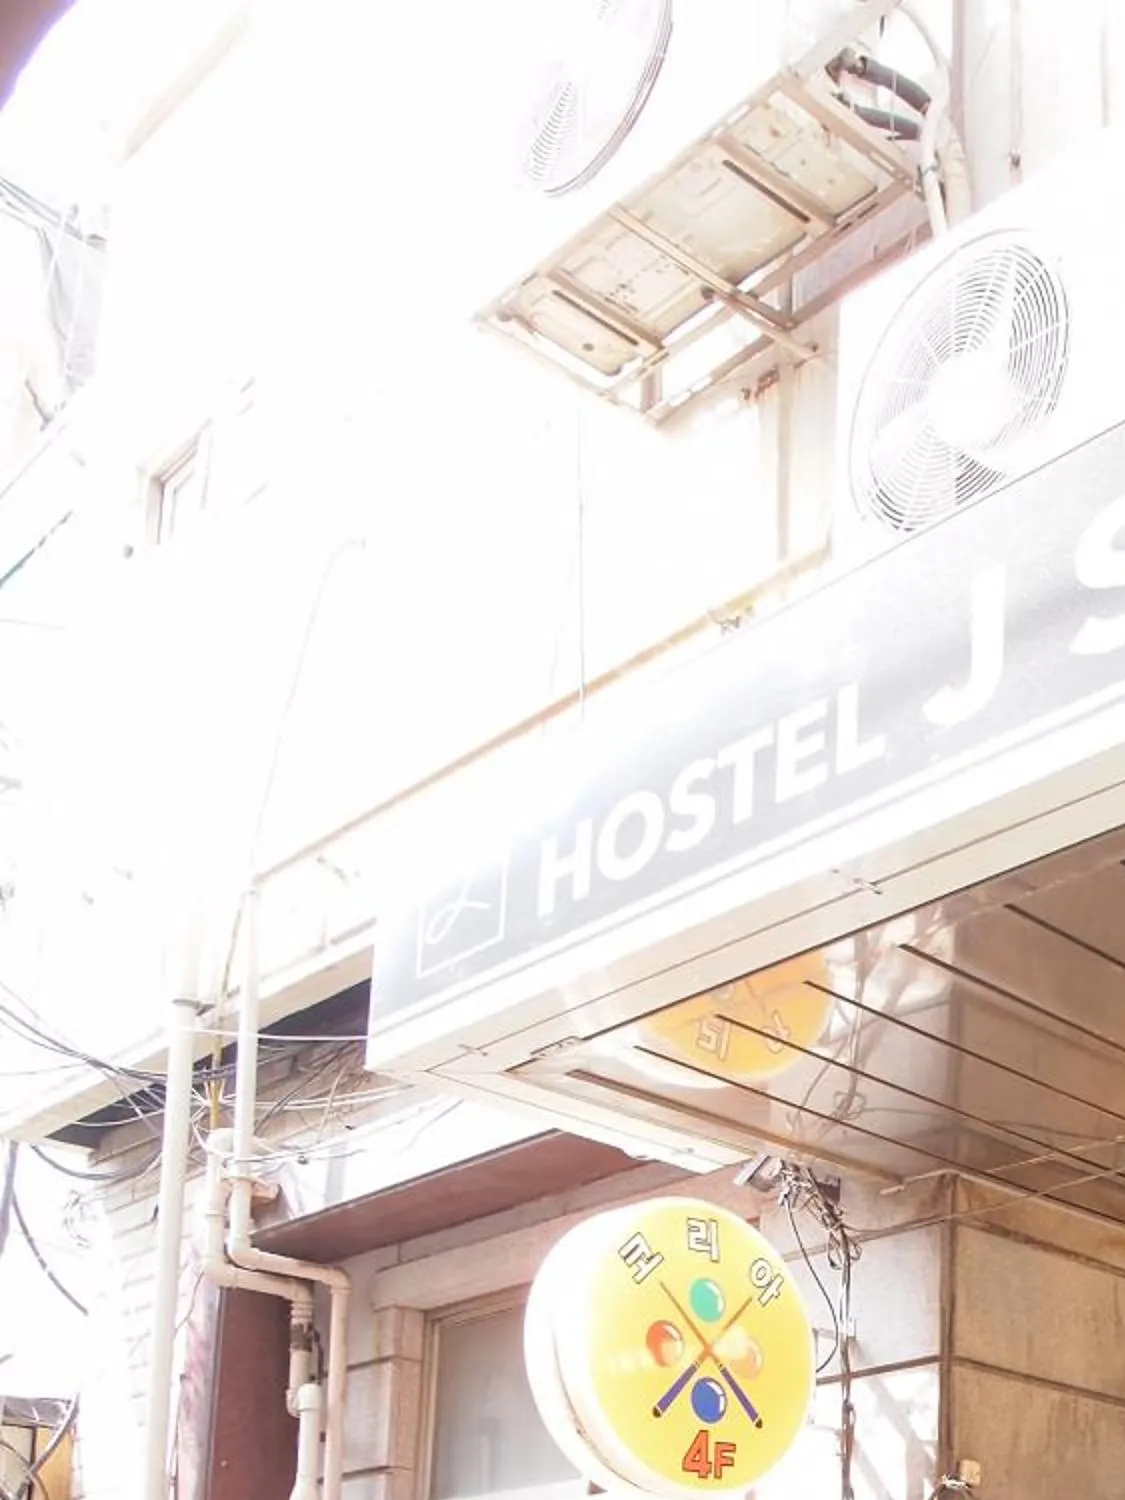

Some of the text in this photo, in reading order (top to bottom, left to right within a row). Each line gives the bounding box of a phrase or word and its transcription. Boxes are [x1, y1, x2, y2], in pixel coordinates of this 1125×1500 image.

[537, 680, 886, 920] HOSTEL
[923, 561, 1005, 728] J
[682, 1430, 737, 1480] 4F
